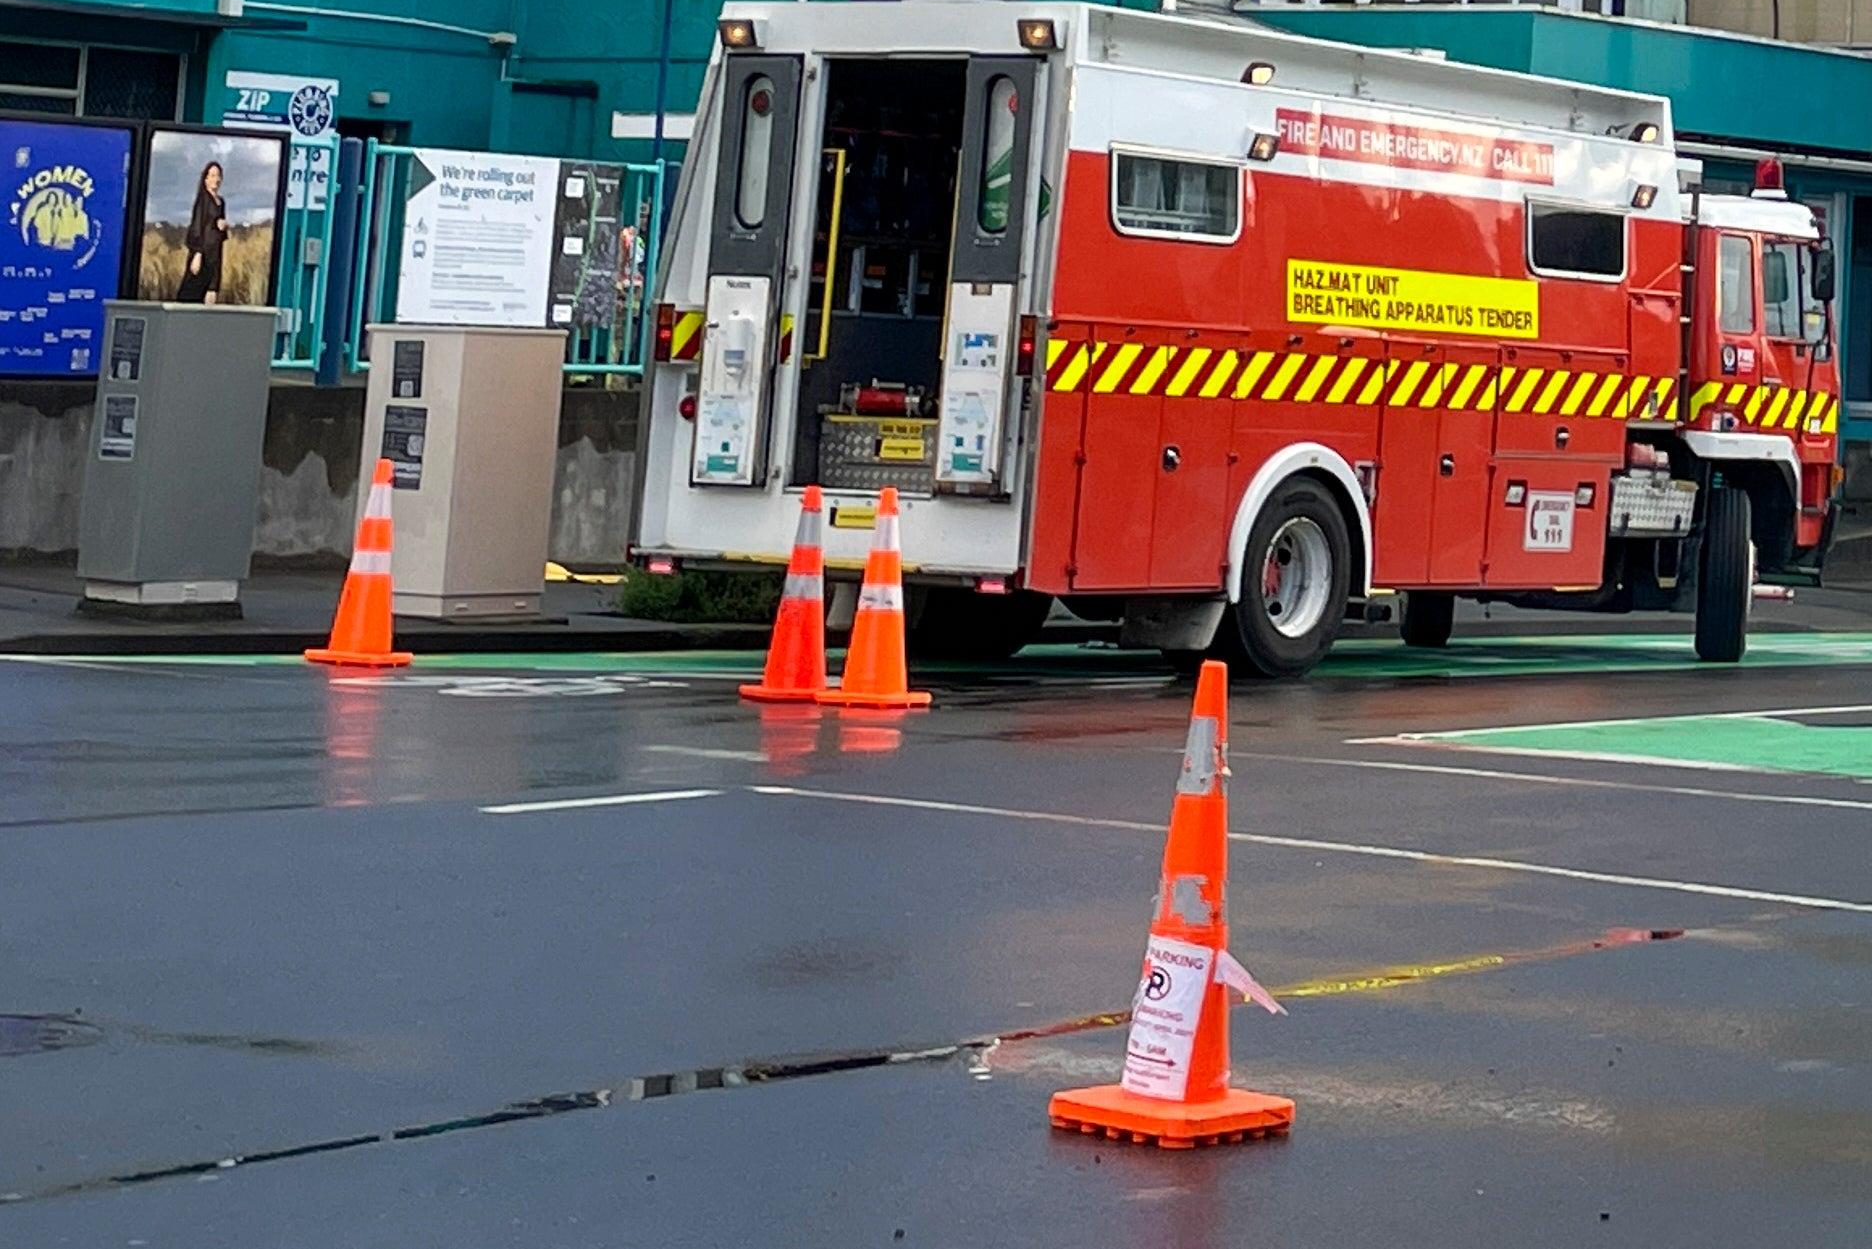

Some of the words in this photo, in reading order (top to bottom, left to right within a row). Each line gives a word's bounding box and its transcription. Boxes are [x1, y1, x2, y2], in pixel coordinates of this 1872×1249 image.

[236, 90, 270, 112] ZIP
[1277, 118, 1316, 146] FIRE
[1319, 124, 1356, 152] AND
[1493, 148, 1532, 172] CALL
[17, 165, 95, 200] WOMEN
[442, 164, 476, 182] We're
[477, 169, 514, 186] rolling
[515, 171, 536, 185] out
[440, 182, 459, 198] the
[461, 186, 495, 202] green
[497, 188, 534, 205] carpet
[1366, 275, 1400, 296] UNIT
[1293, 293, 1380, 320] BREATHING
[1385, 300, 1474, 327] APPARATUS
[1479, 308, 1533, 331] TENDER
